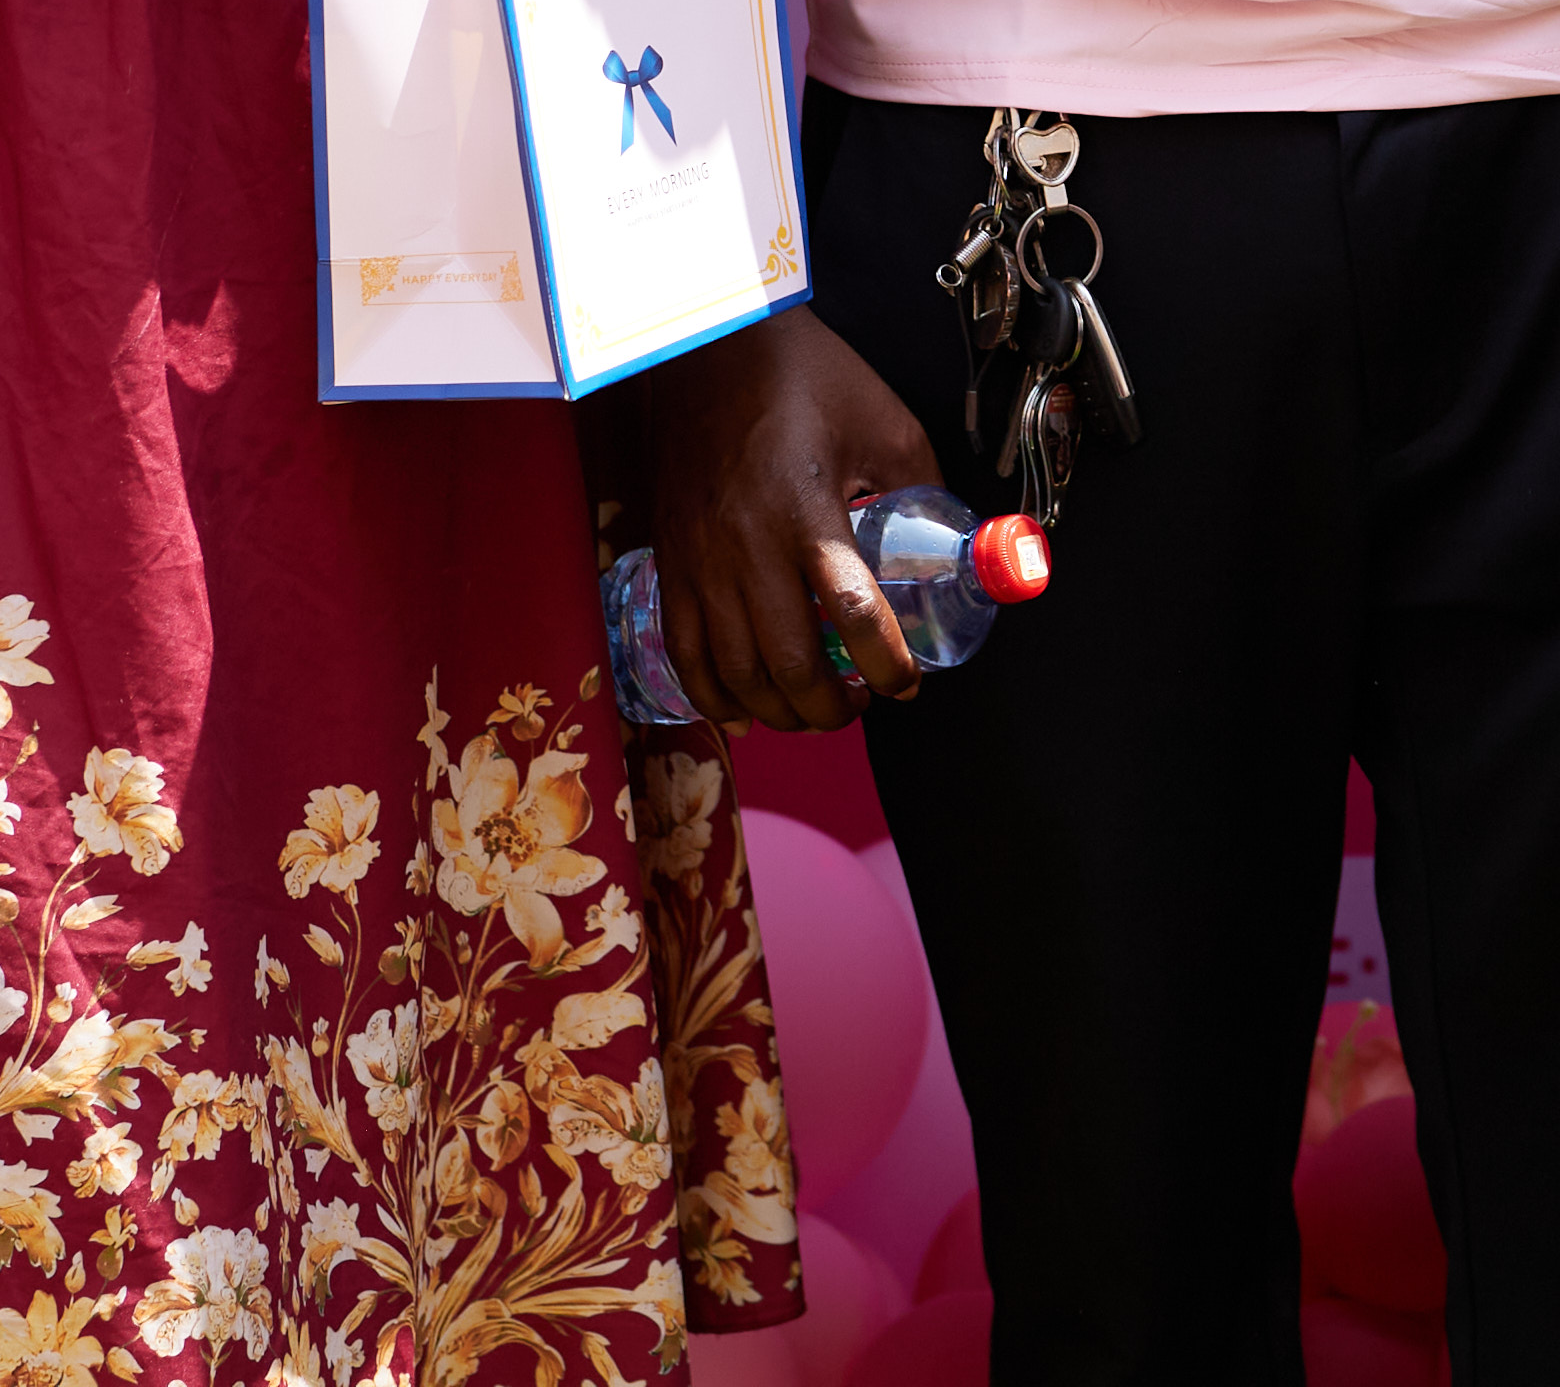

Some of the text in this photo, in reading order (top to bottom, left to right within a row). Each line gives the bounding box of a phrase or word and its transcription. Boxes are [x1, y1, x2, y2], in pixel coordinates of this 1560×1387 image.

[607, 186, 643, 215] EVERY
[649, 162, 710, 196] MORNING
[402, 273, 442, 284] HAPPY
